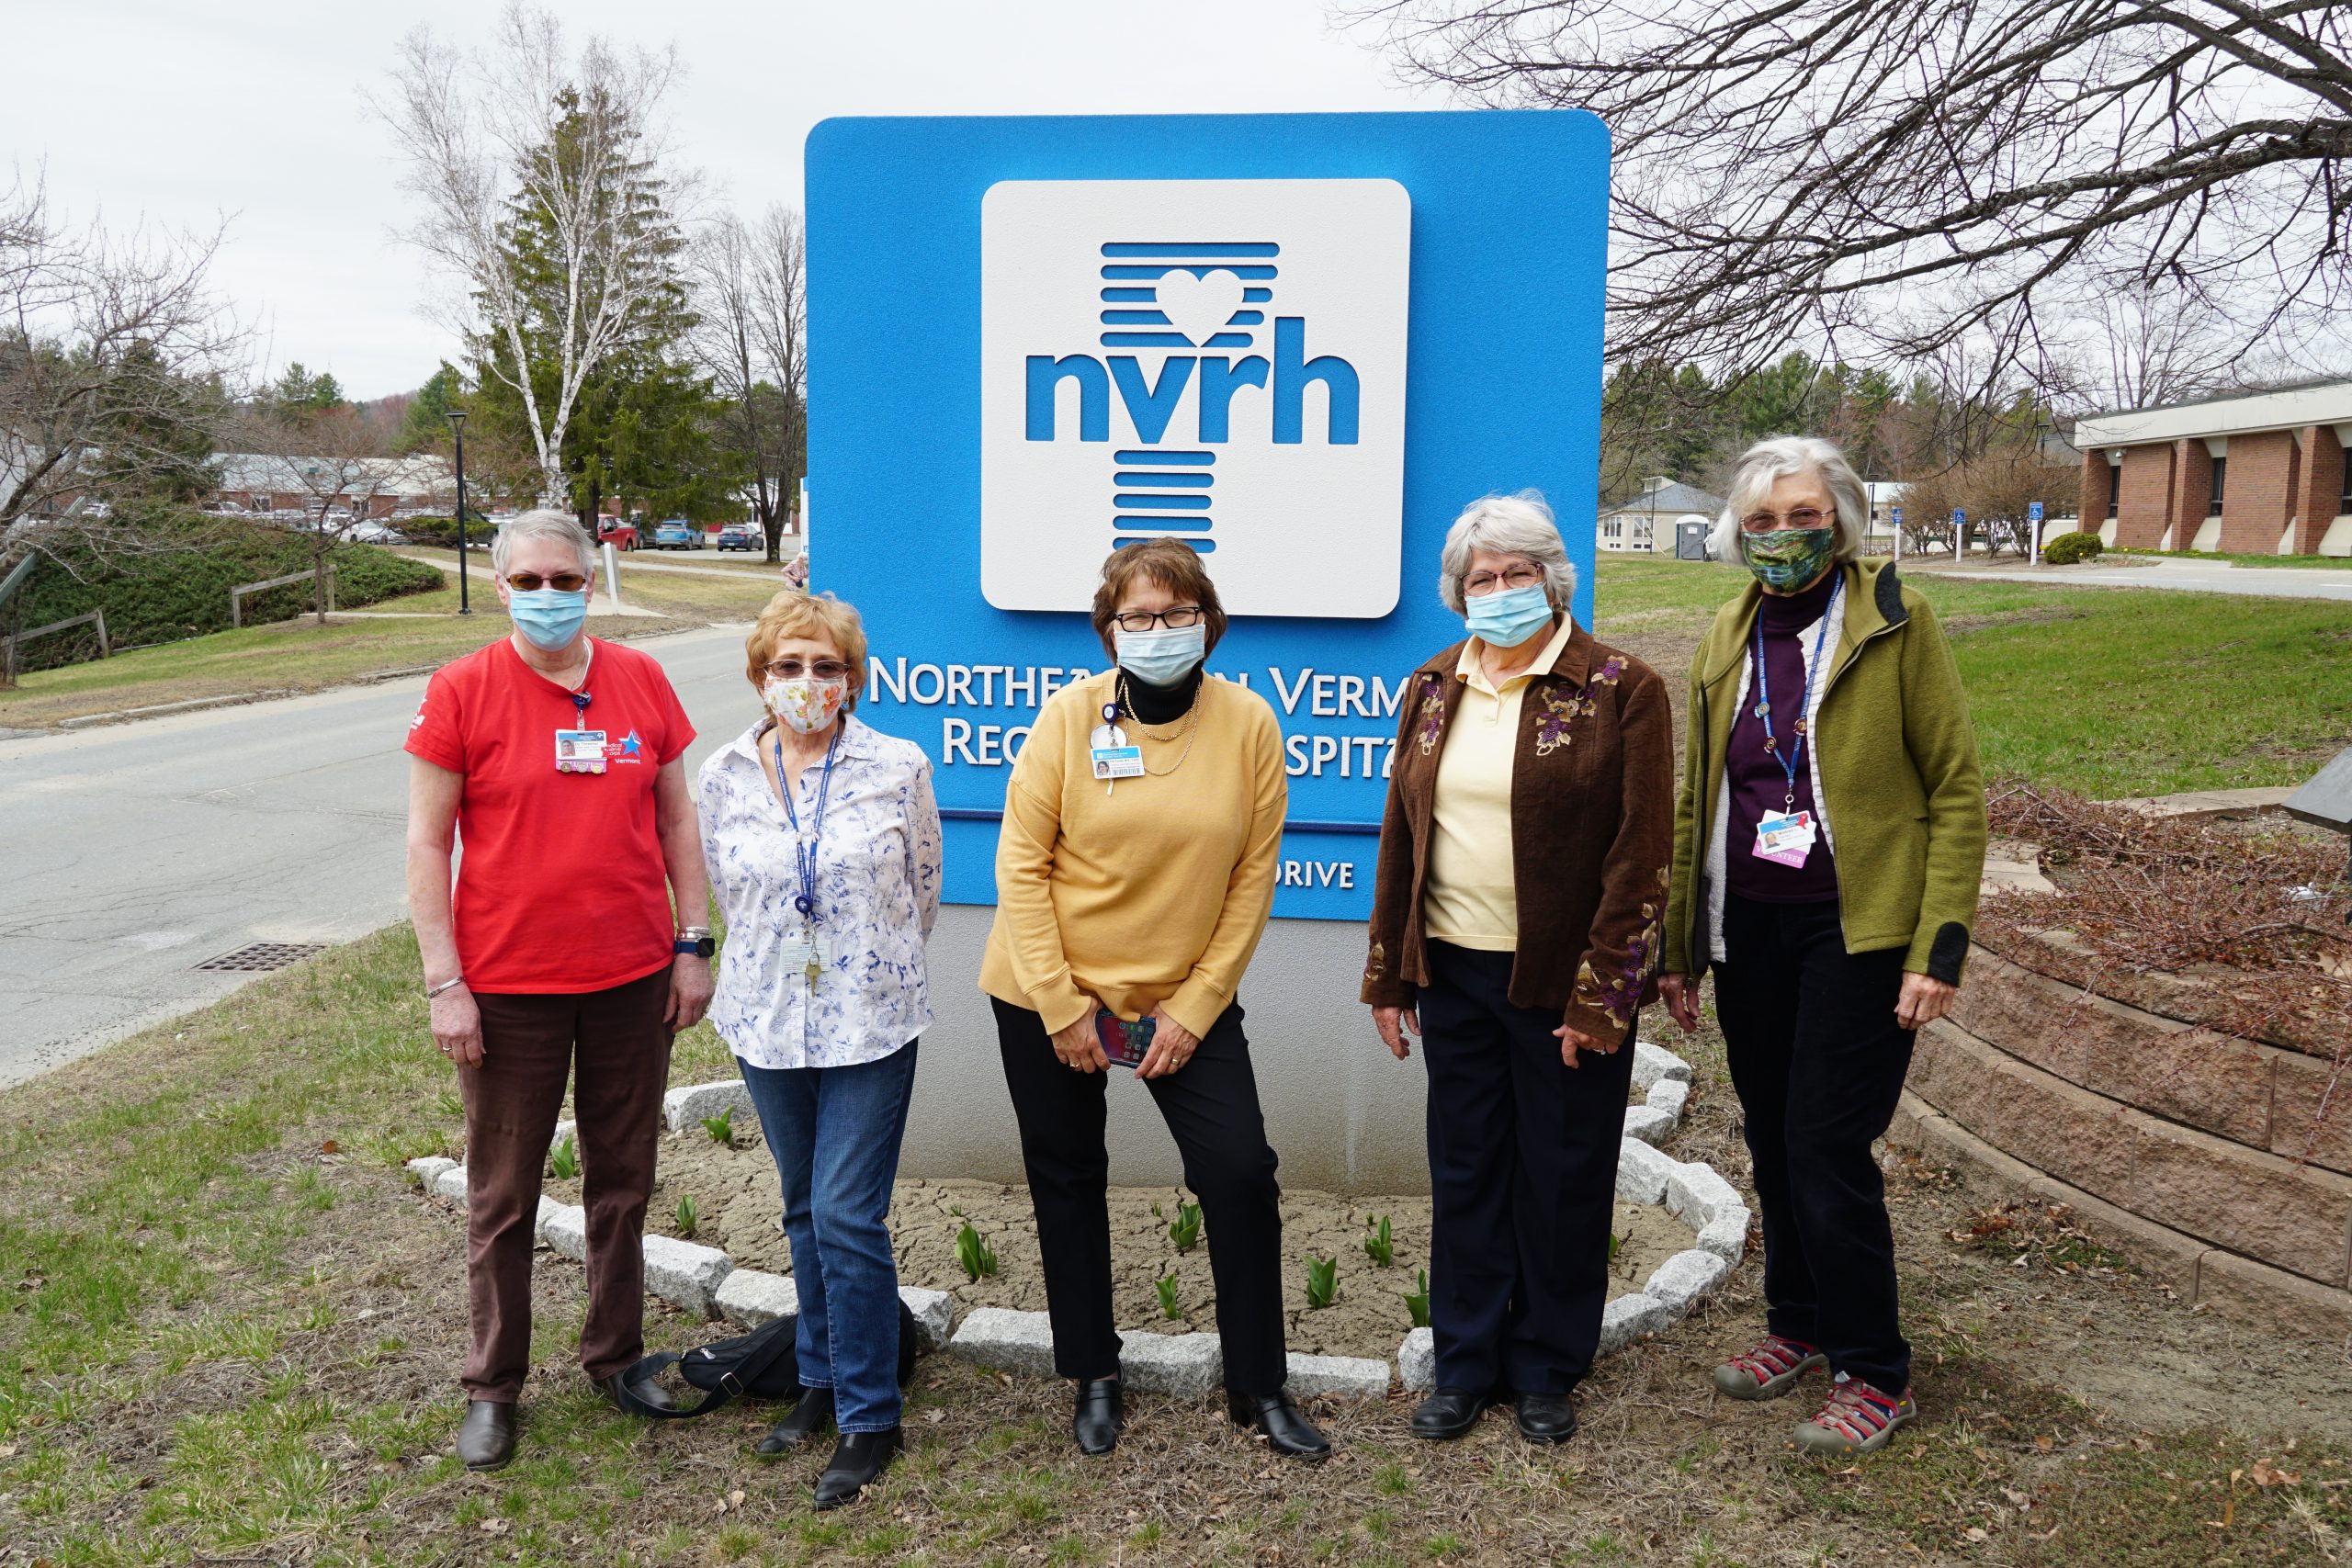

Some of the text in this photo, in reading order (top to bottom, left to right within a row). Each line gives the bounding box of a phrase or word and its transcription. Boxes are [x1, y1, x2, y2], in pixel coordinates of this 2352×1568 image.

[1025, 317, 1360, 445] nvrh
[1268, 667, 1410, 717] VERM
[1285, 735, 1396, 778] SPIT
